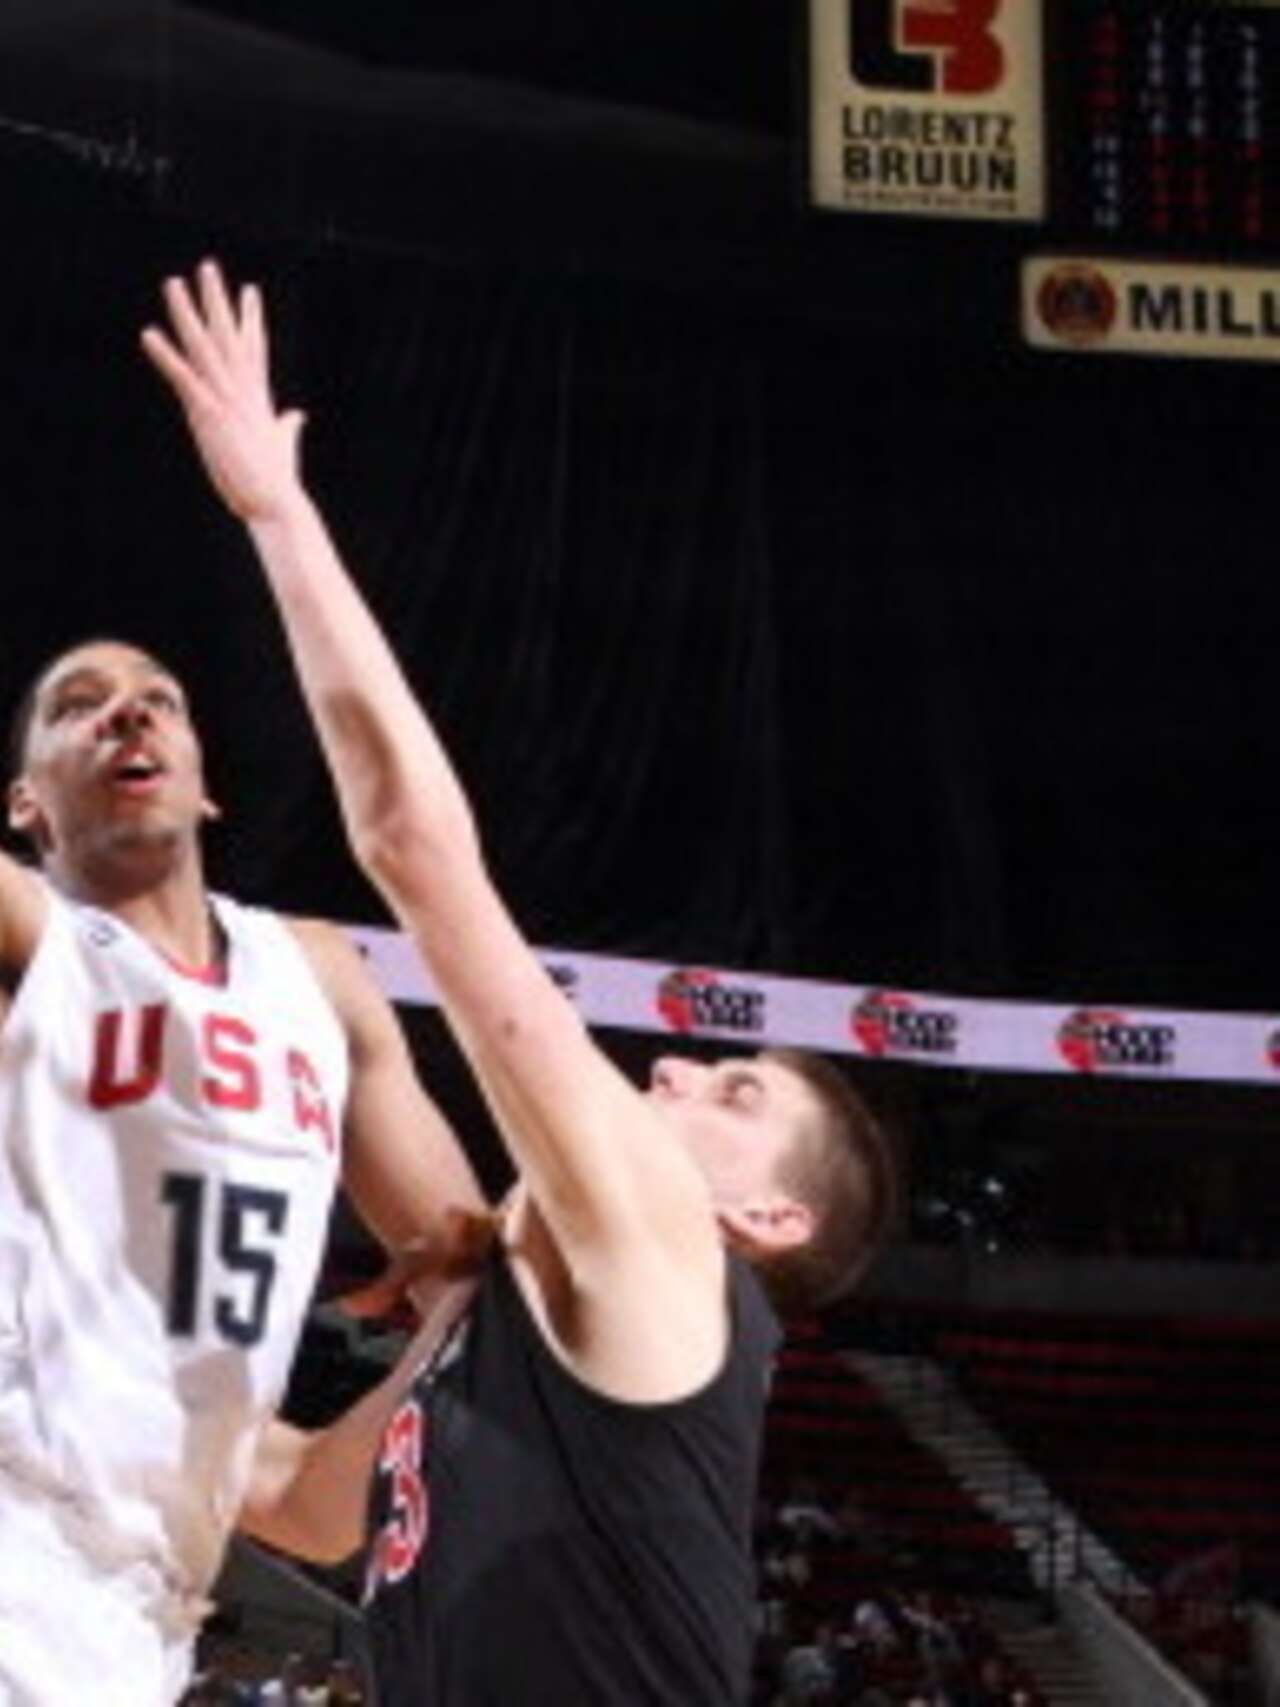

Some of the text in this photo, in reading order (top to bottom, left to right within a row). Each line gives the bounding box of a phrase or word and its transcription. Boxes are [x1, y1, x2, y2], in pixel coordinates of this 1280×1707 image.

[841, 105, 1016, 151] LORENTZ
[842, 146, 1017, 192] BRUUN
[88, 1003, 336, 1153] USA
[159, 1171, 289, 1348] 15
